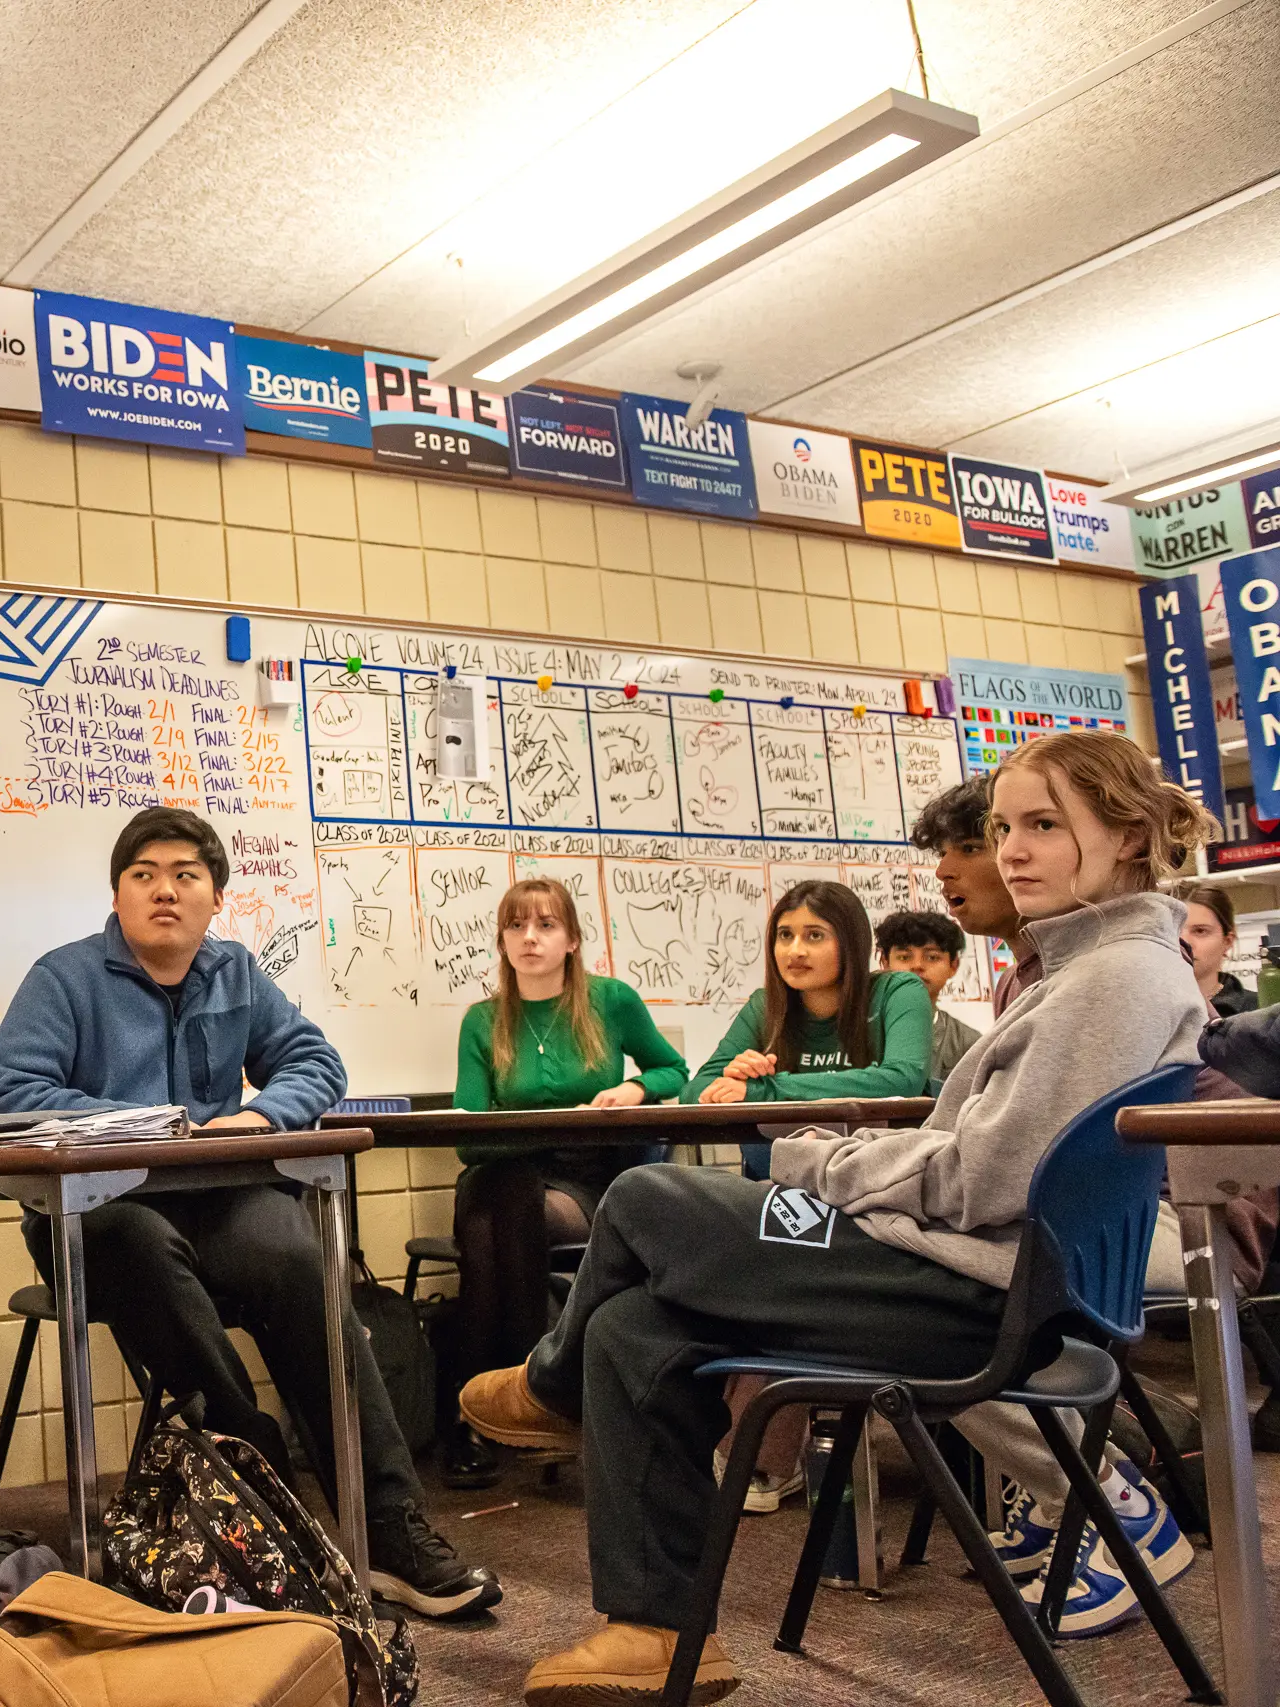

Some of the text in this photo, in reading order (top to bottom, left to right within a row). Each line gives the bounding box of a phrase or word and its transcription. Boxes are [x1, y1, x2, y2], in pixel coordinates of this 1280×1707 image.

[48, 313, 228, 391] BIDEN
[53, 370, 229, 412] WORKS FOR IOWA
[246, 364, 361, 413] Bernie
[87, 407, 202, 432] WWW.JOEBIDEN.COM
[520, 416, 584, 433] NOT NOT
[636, 407, 736, 457] WARREN
[414, 431, 470, 455] 2020
[520, 426, 616, 458] FORWARD
[644, 468, 742, 497] TEXT FIGHT TO 24477
[773, 462, 839, 489] OBAMA
[859, 448, 951, 505] PETE
[781, 483, 837, 505] BIDEN
[957, 470, 1044, 517] IOWA
[1049, 483, 1087, 507] Love
[893, 508, 932, 527] 2020
[964, 506, 1046, 530] FOR BULLOCK
[1052, 507, 1110, 534] trumps
[1057, 530, 1099, 552] hate.
[1139, 520, 1229, 563] WARREN
[126, 640, 206, 666] SEMESTER
[304, 623, 384, 663] ALCOVE
[396, 634, 455, 667] VOLUME
[566, 649, 602, 681] MAY
[635, 656, 682, 686] 2024
[62, 657, 240, 701] JOURNALISM DEADLINES
[710, 667, 741, 687] SEND
[744, 674, 761, 688] TO
[845, 685, 879, 704] APRIL
[881, 688, 898, 708] 29
[958, 672, 1123, 711] FLAGS OF THE WORLD
[1240, 578, 1280, 791] OBAM
[18, 688, 70, 714] STORY
[236, 705, 269, 728] 2/7
[830, 711, 884, 733] SPORTS
[20, 713, 74, 738] STORY
[241, 730, 279, 751] 2/15
[26, 735, 78, 757] STORY
[242, 752, 292, 774] 3/22
[758, 734, 807, 767] FACULTY
[24, 756, 83, 783] STORY
[248, 775, 290, 793] 4/17
[766, 760, 819, 783] FAMILIES
[27, 779, 85, 808] STORY
[251, 797, 297, 811] ANYTIME
[232, 829, 279, 857] MEGAN
[316, 825, 410, 844] CLASS OF 2024
[415, 829, 506, 847] CLASS OF 2024
[514, 834, 595, 854] CLASS OF 2024
[229, 858, 298, 879] GRAPHICS
[431, 865, 493, 908] SENIOR
[628, 958, 684, 989] STATS
